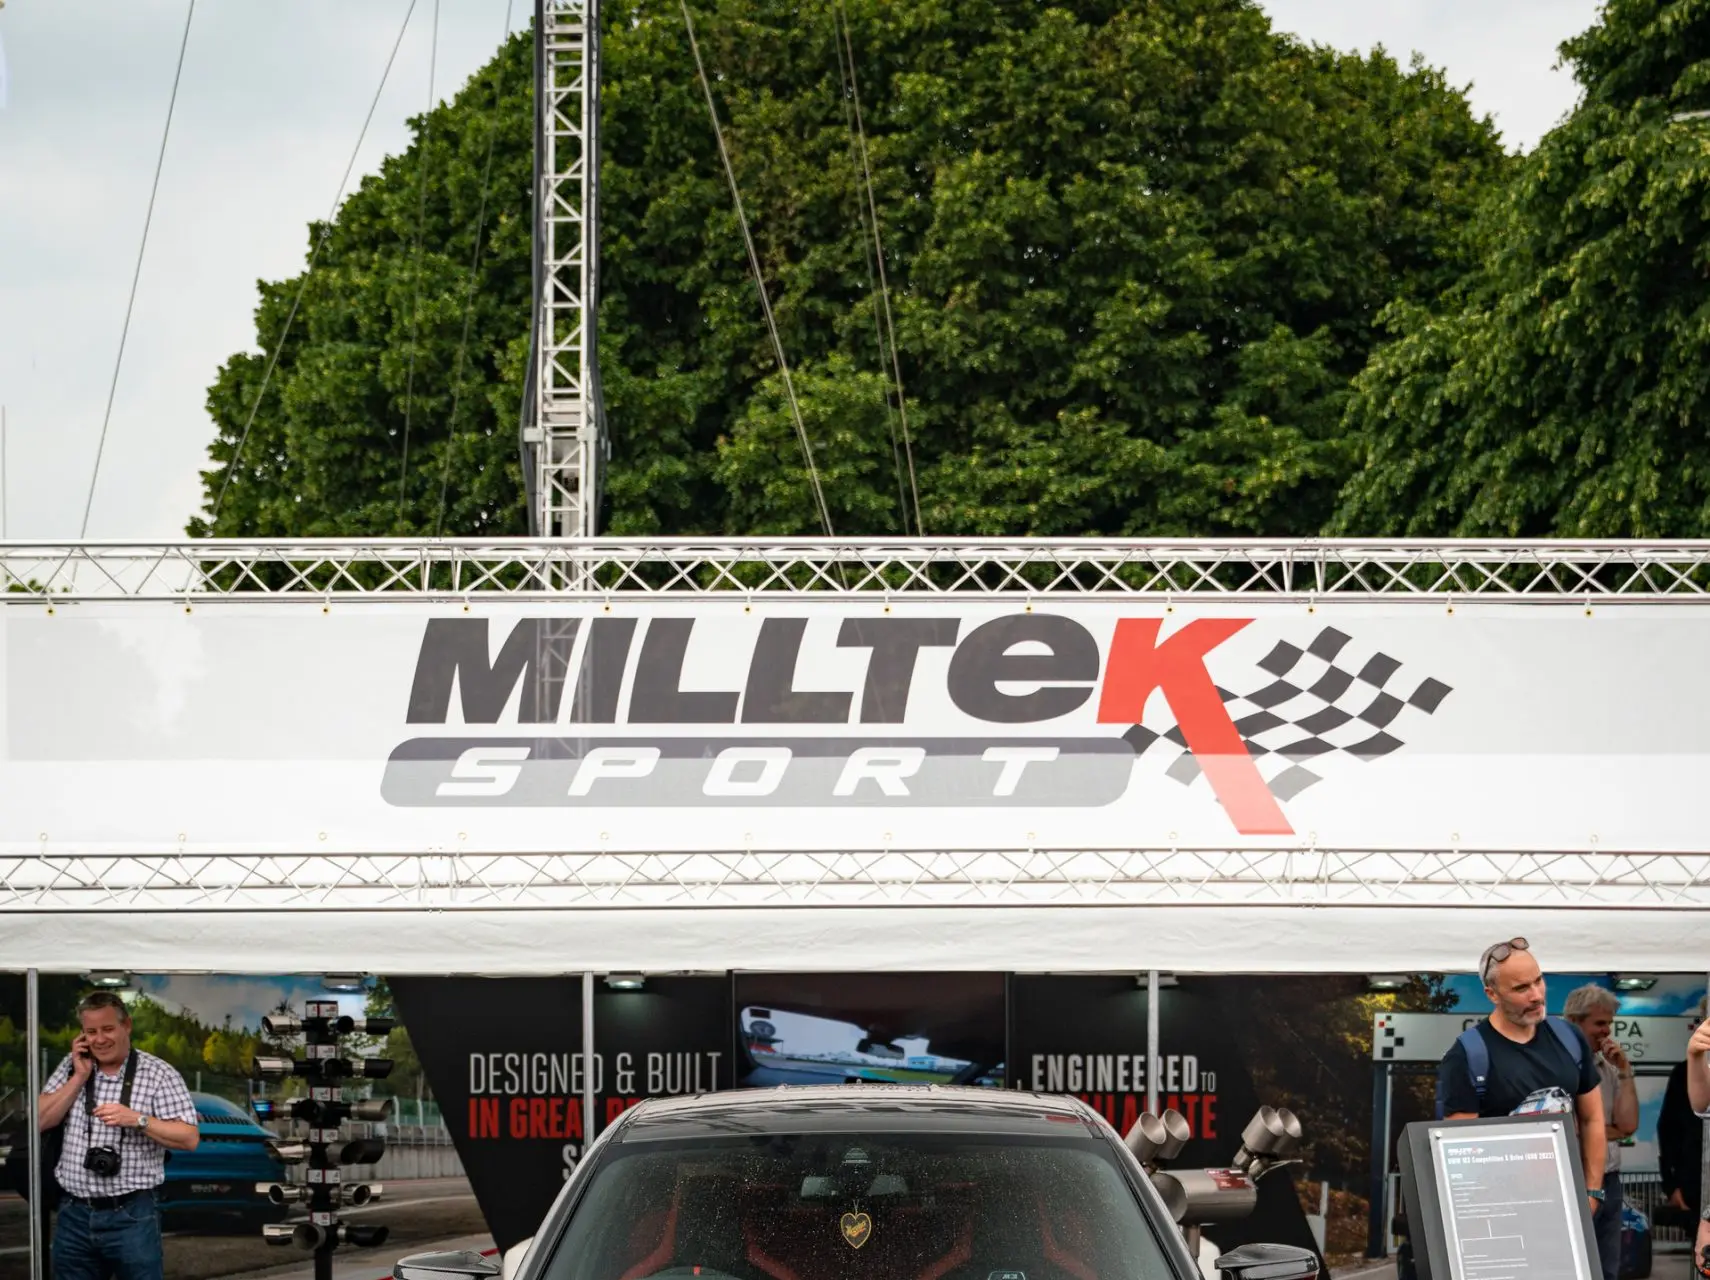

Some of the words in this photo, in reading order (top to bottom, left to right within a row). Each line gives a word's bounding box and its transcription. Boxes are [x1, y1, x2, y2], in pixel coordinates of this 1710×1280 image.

[434, 745, 1062, 797] SPORT
[616, 1053, 636, 1094] &
[648, 1052, 722, 1093] BUILT
[1200, 1071, 1217, 1092] TO
[469, 1097, 499, 1138] IN
